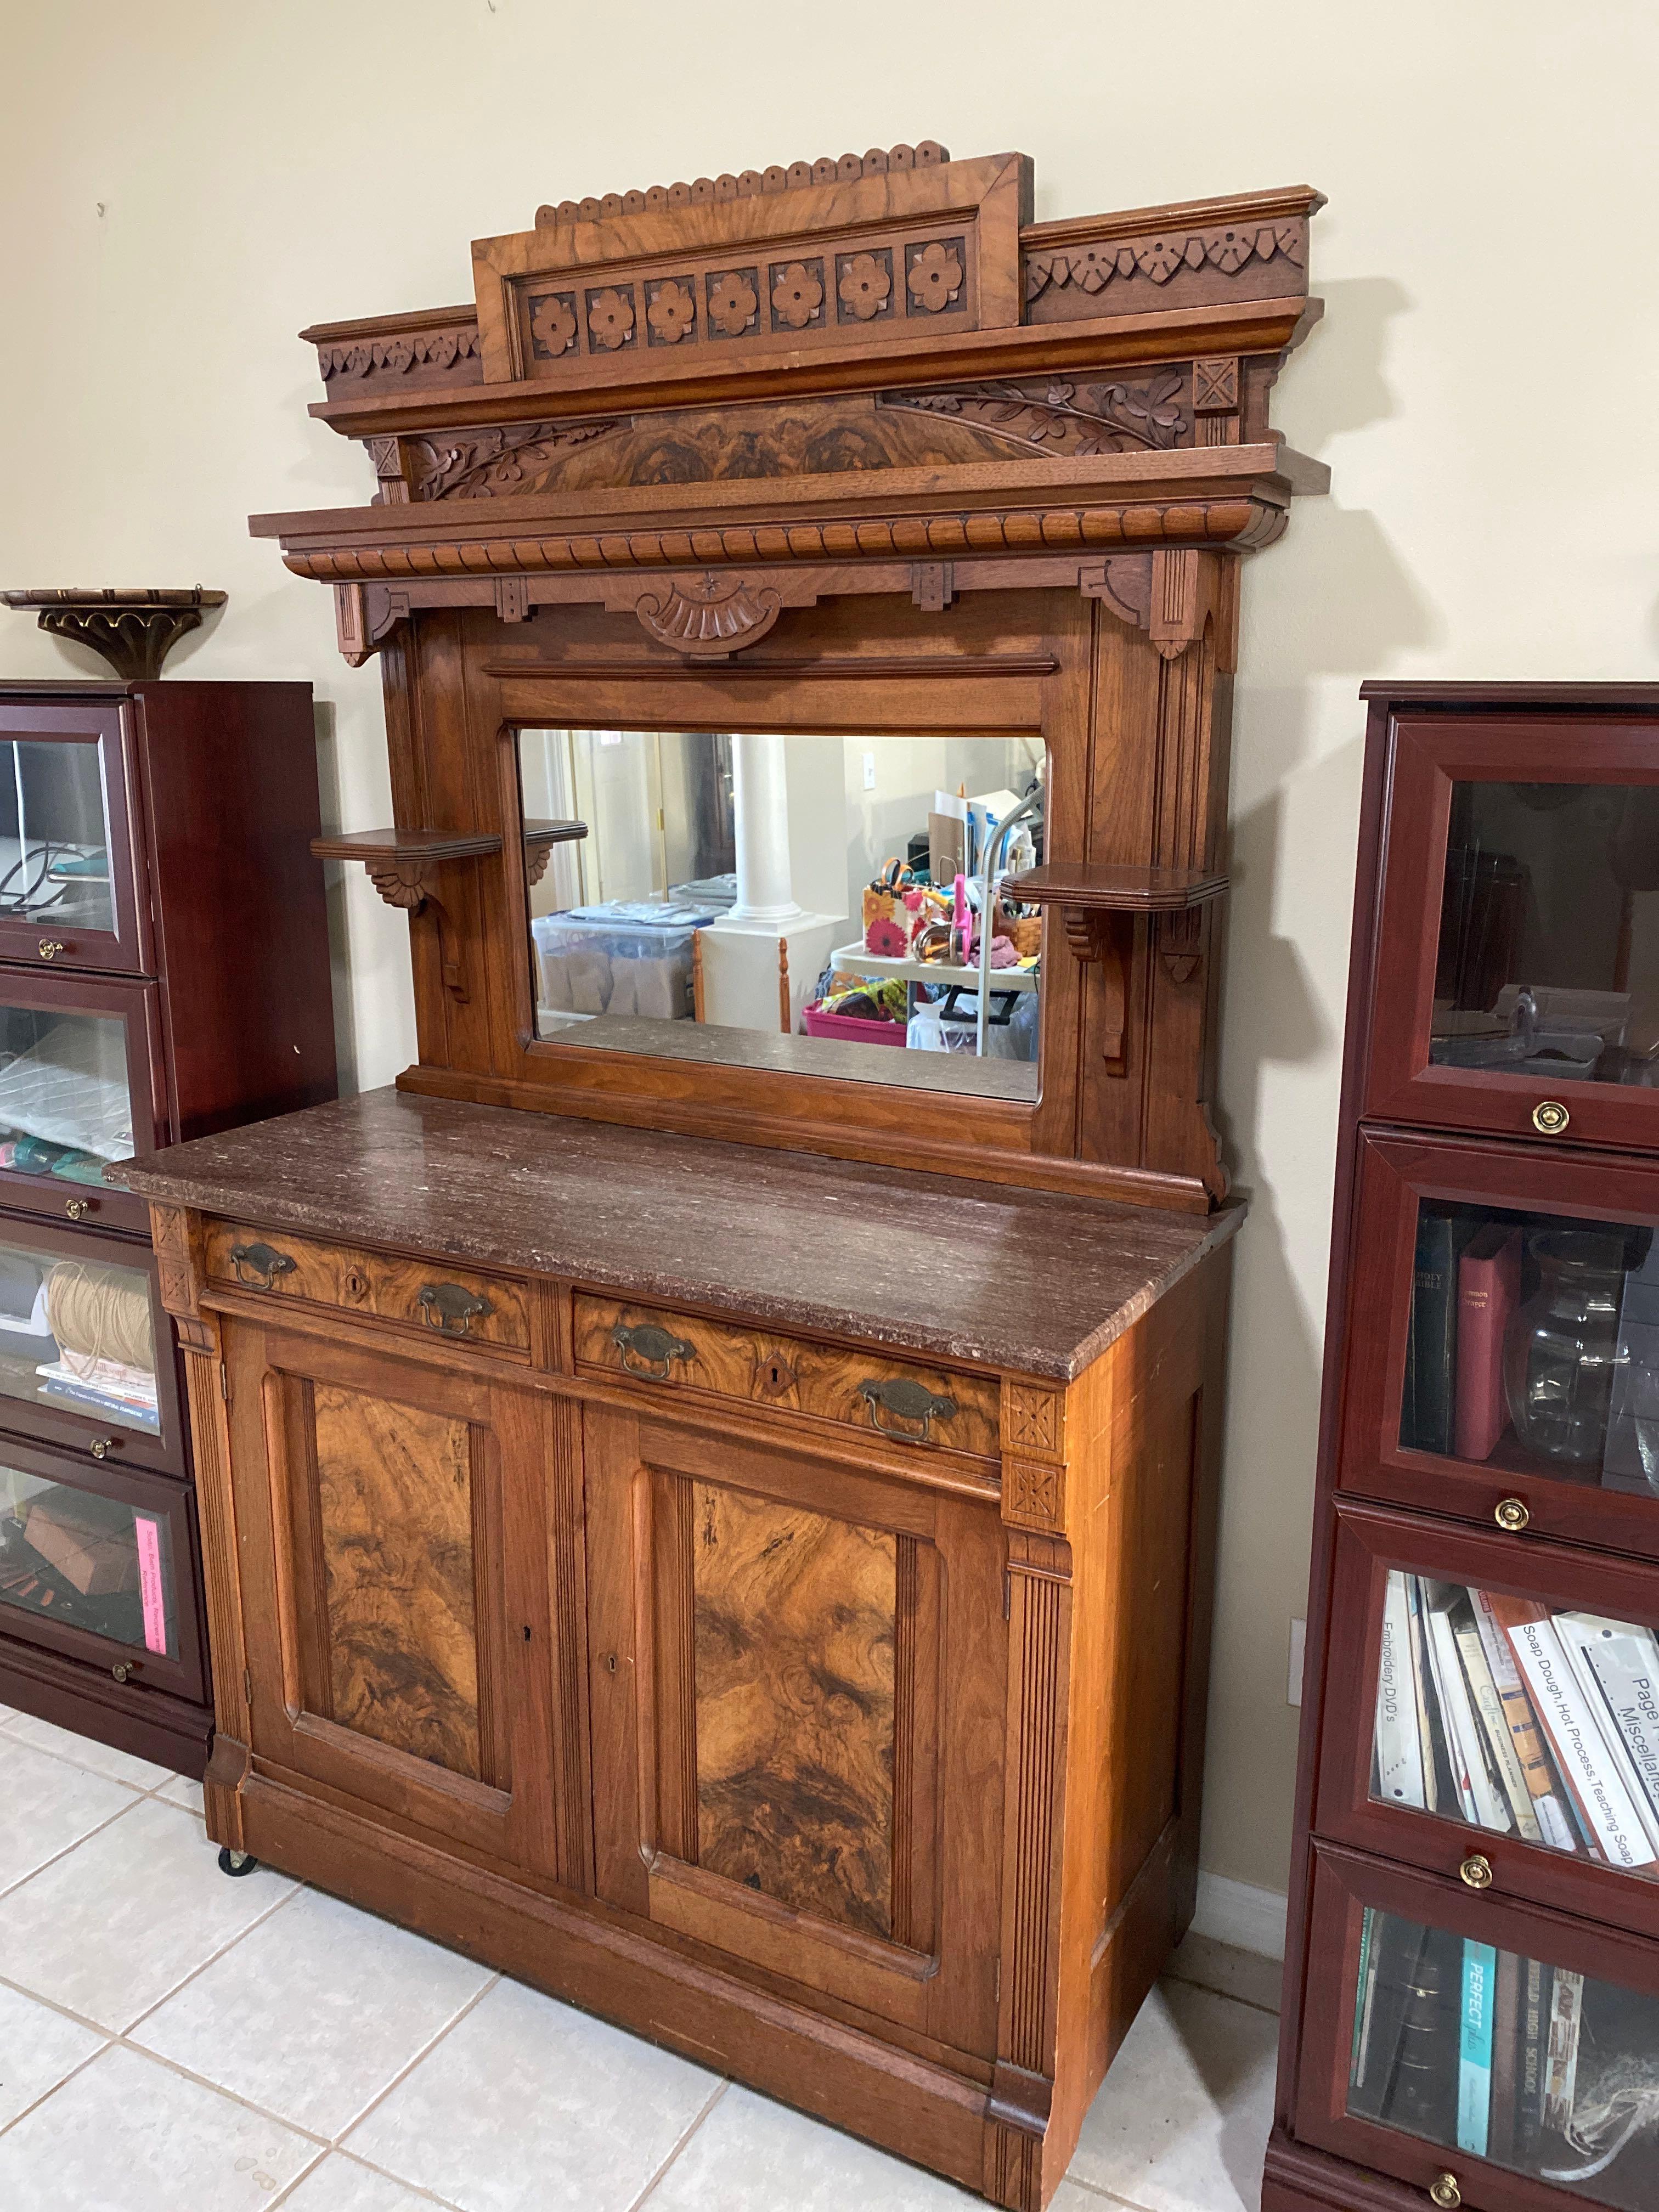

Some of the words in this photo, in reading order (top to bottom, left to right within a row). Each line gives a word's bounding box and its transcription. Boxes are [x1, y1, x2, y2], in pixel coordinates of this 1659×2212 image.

[1382, 1622, 1395, 1685] Embroidery
[1385, 1688, 1397, 1722] DVD's
[1632, 1678, 1658, 1720] Page
[1495, 1729, 1508, 1758] BUSINESS
[1505, 1759, 1518, 1788] PLANNER
[1523, 1626, 1543, 1657] Soap
[1615, 1834, 1633, 1865] Soap
[1469, 1961, 1483, 2029] PERFECT
